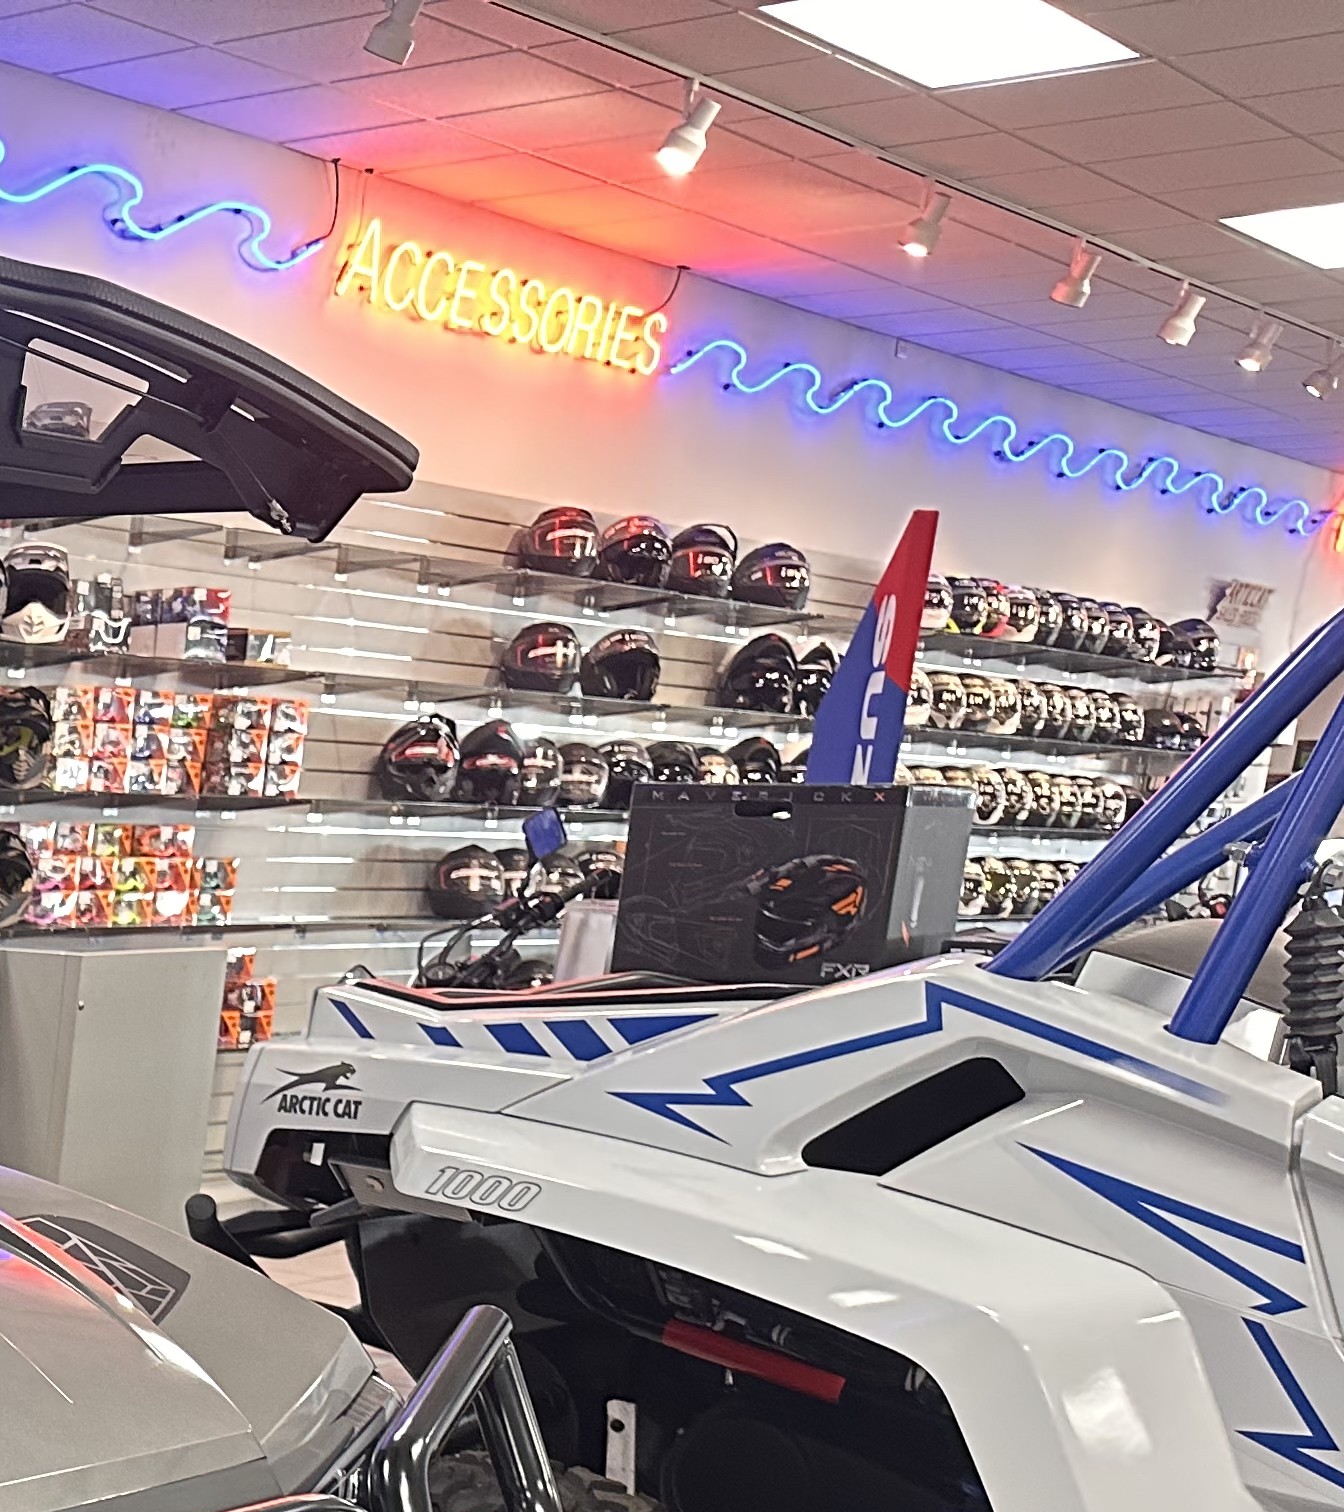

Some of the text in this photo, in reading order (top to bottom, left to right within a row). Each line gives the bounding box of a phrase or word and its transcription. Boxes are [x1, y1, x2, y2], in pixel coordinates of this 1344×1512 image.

[334, 217, 668, 376] ACCESSORIES
[820, 961, 871, 979] FXR
[276, 1093, 363, 1121] ARCTIC CAT
[424, 1165, 543, 1213] 1000
